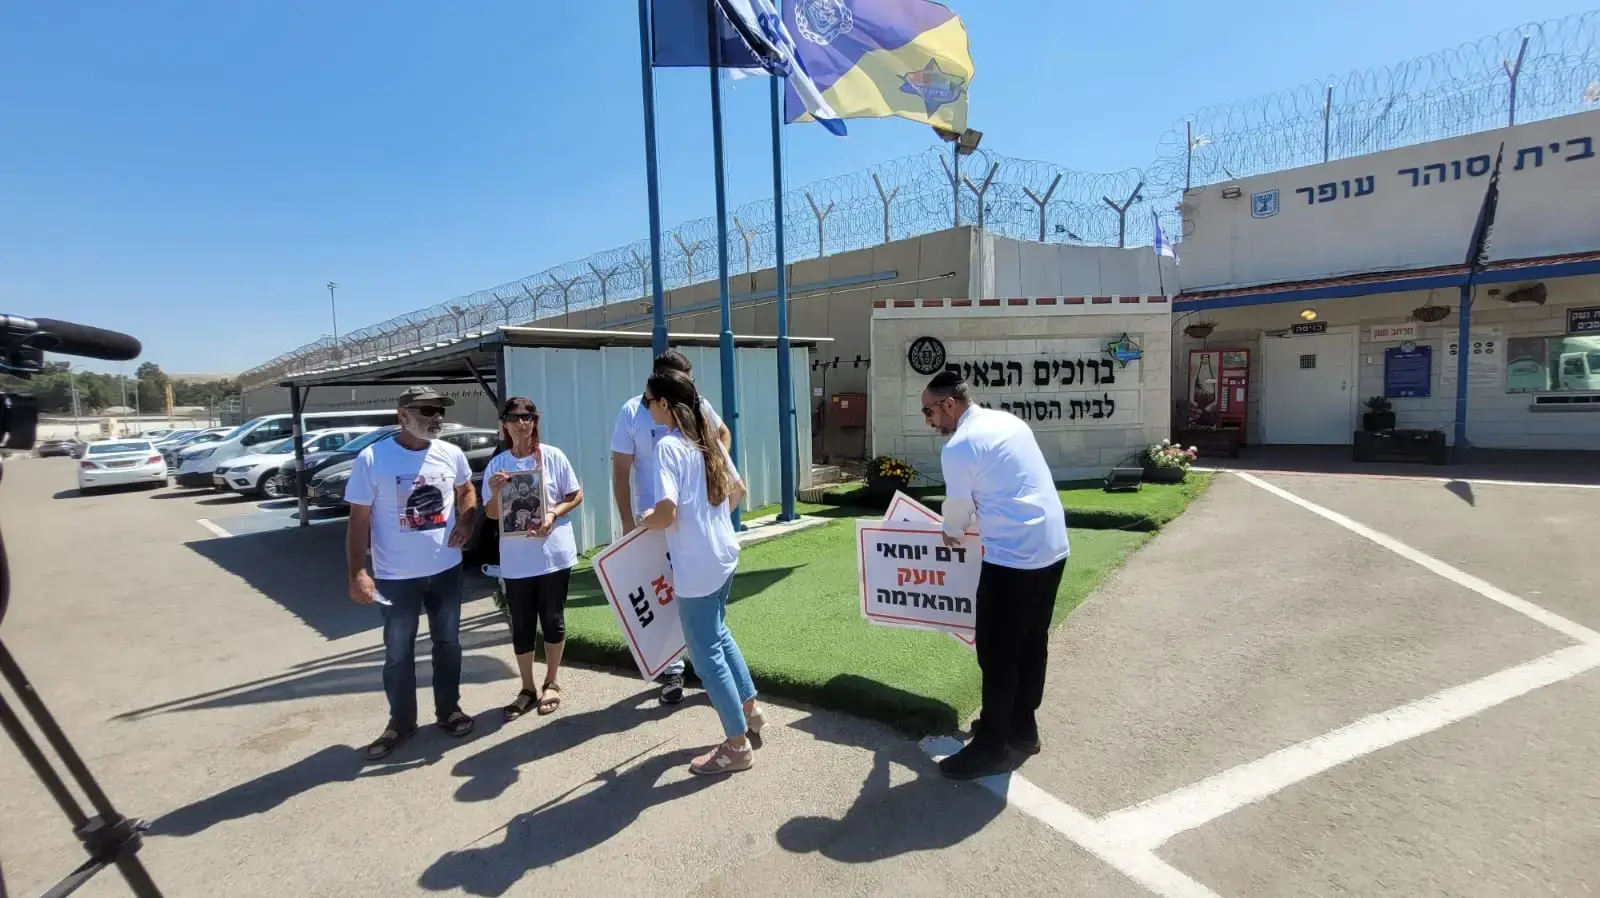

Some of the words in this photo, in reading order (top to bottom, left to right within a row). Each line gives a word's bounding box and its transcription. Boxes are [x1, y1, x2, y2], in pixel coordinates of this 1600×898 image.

[1513, 136, 1595, 171] בית
[1397, 154, 1490, 187] סוהר
[1295, 174, 1374, 206] עופר
[1295, 324, 1323, 333] כניסה
[1033, 357, 1115, 386] ברוכים
[1070, 392, 1115, 420] לבית
[876, 542, 928, 560] יוחאי
[935, 546, 967, 563] דם
[897, 567, 946, 586] זועק
[628, 586, 655, 629] גנב
[876, 588, 972, 614] מהאדמה
